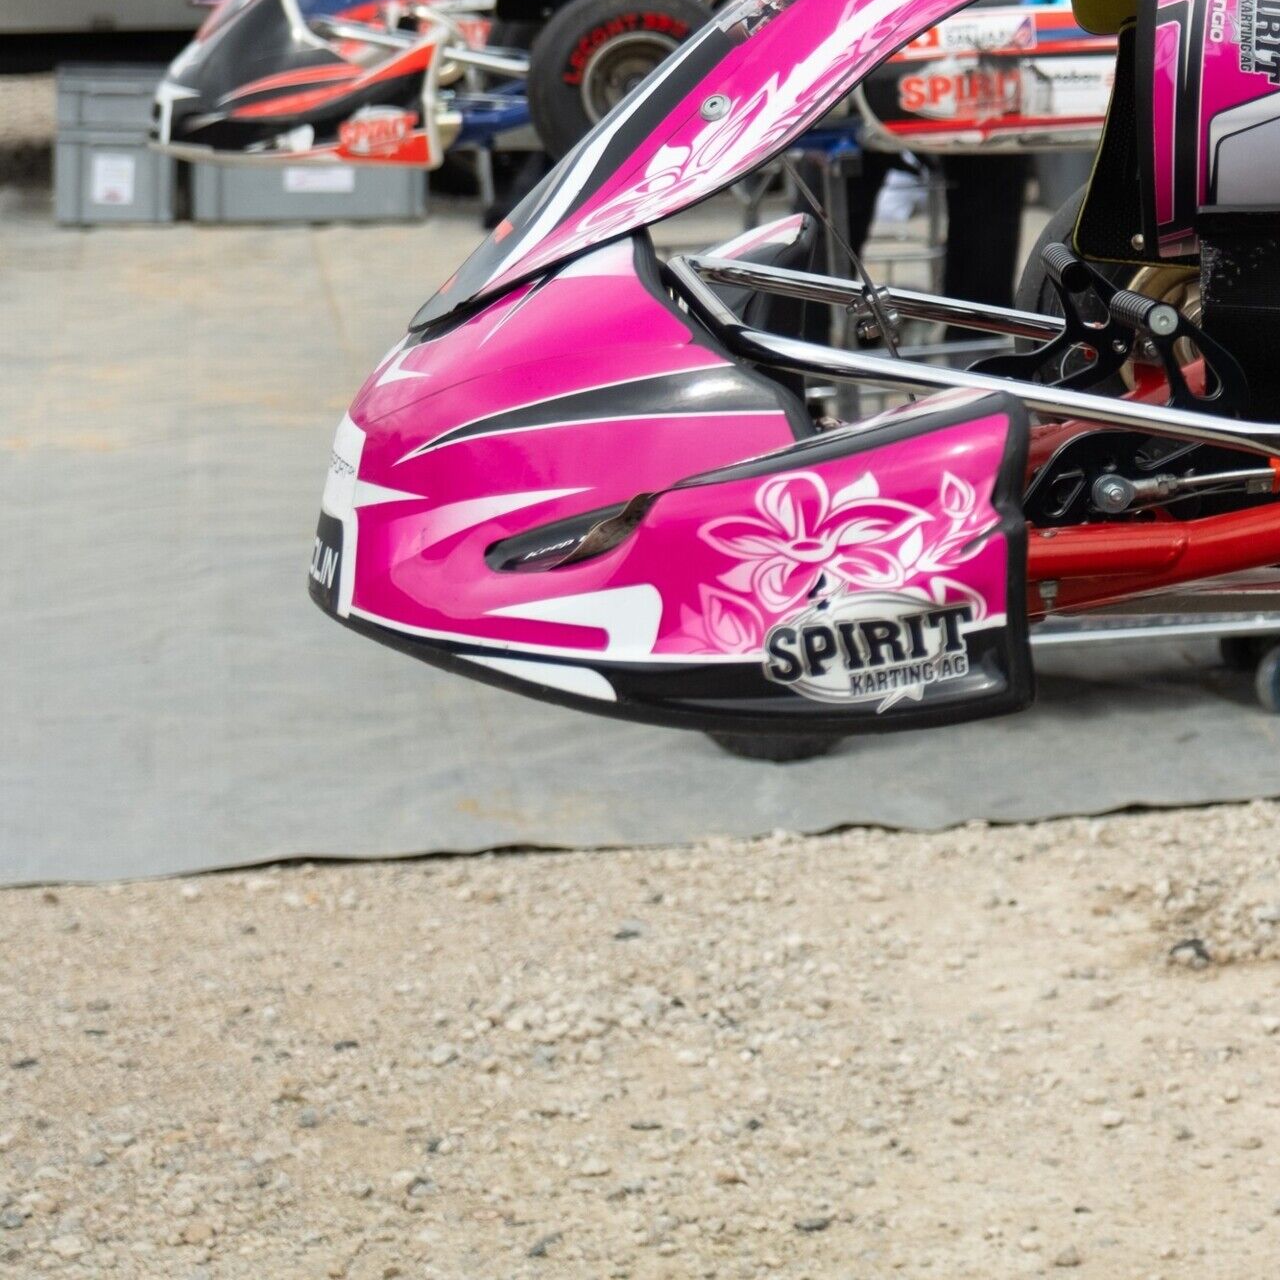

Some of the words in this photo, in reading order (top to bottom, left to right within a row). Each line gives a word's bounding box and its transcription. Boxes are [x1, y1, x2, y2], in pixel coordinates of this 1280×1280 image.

[1239, 54, 1253, 73] AG
[768, 606, 974, 682] SPIRIT
[850, 662, 934, 696] KARTING
[938, 655, 968, 677] AG
